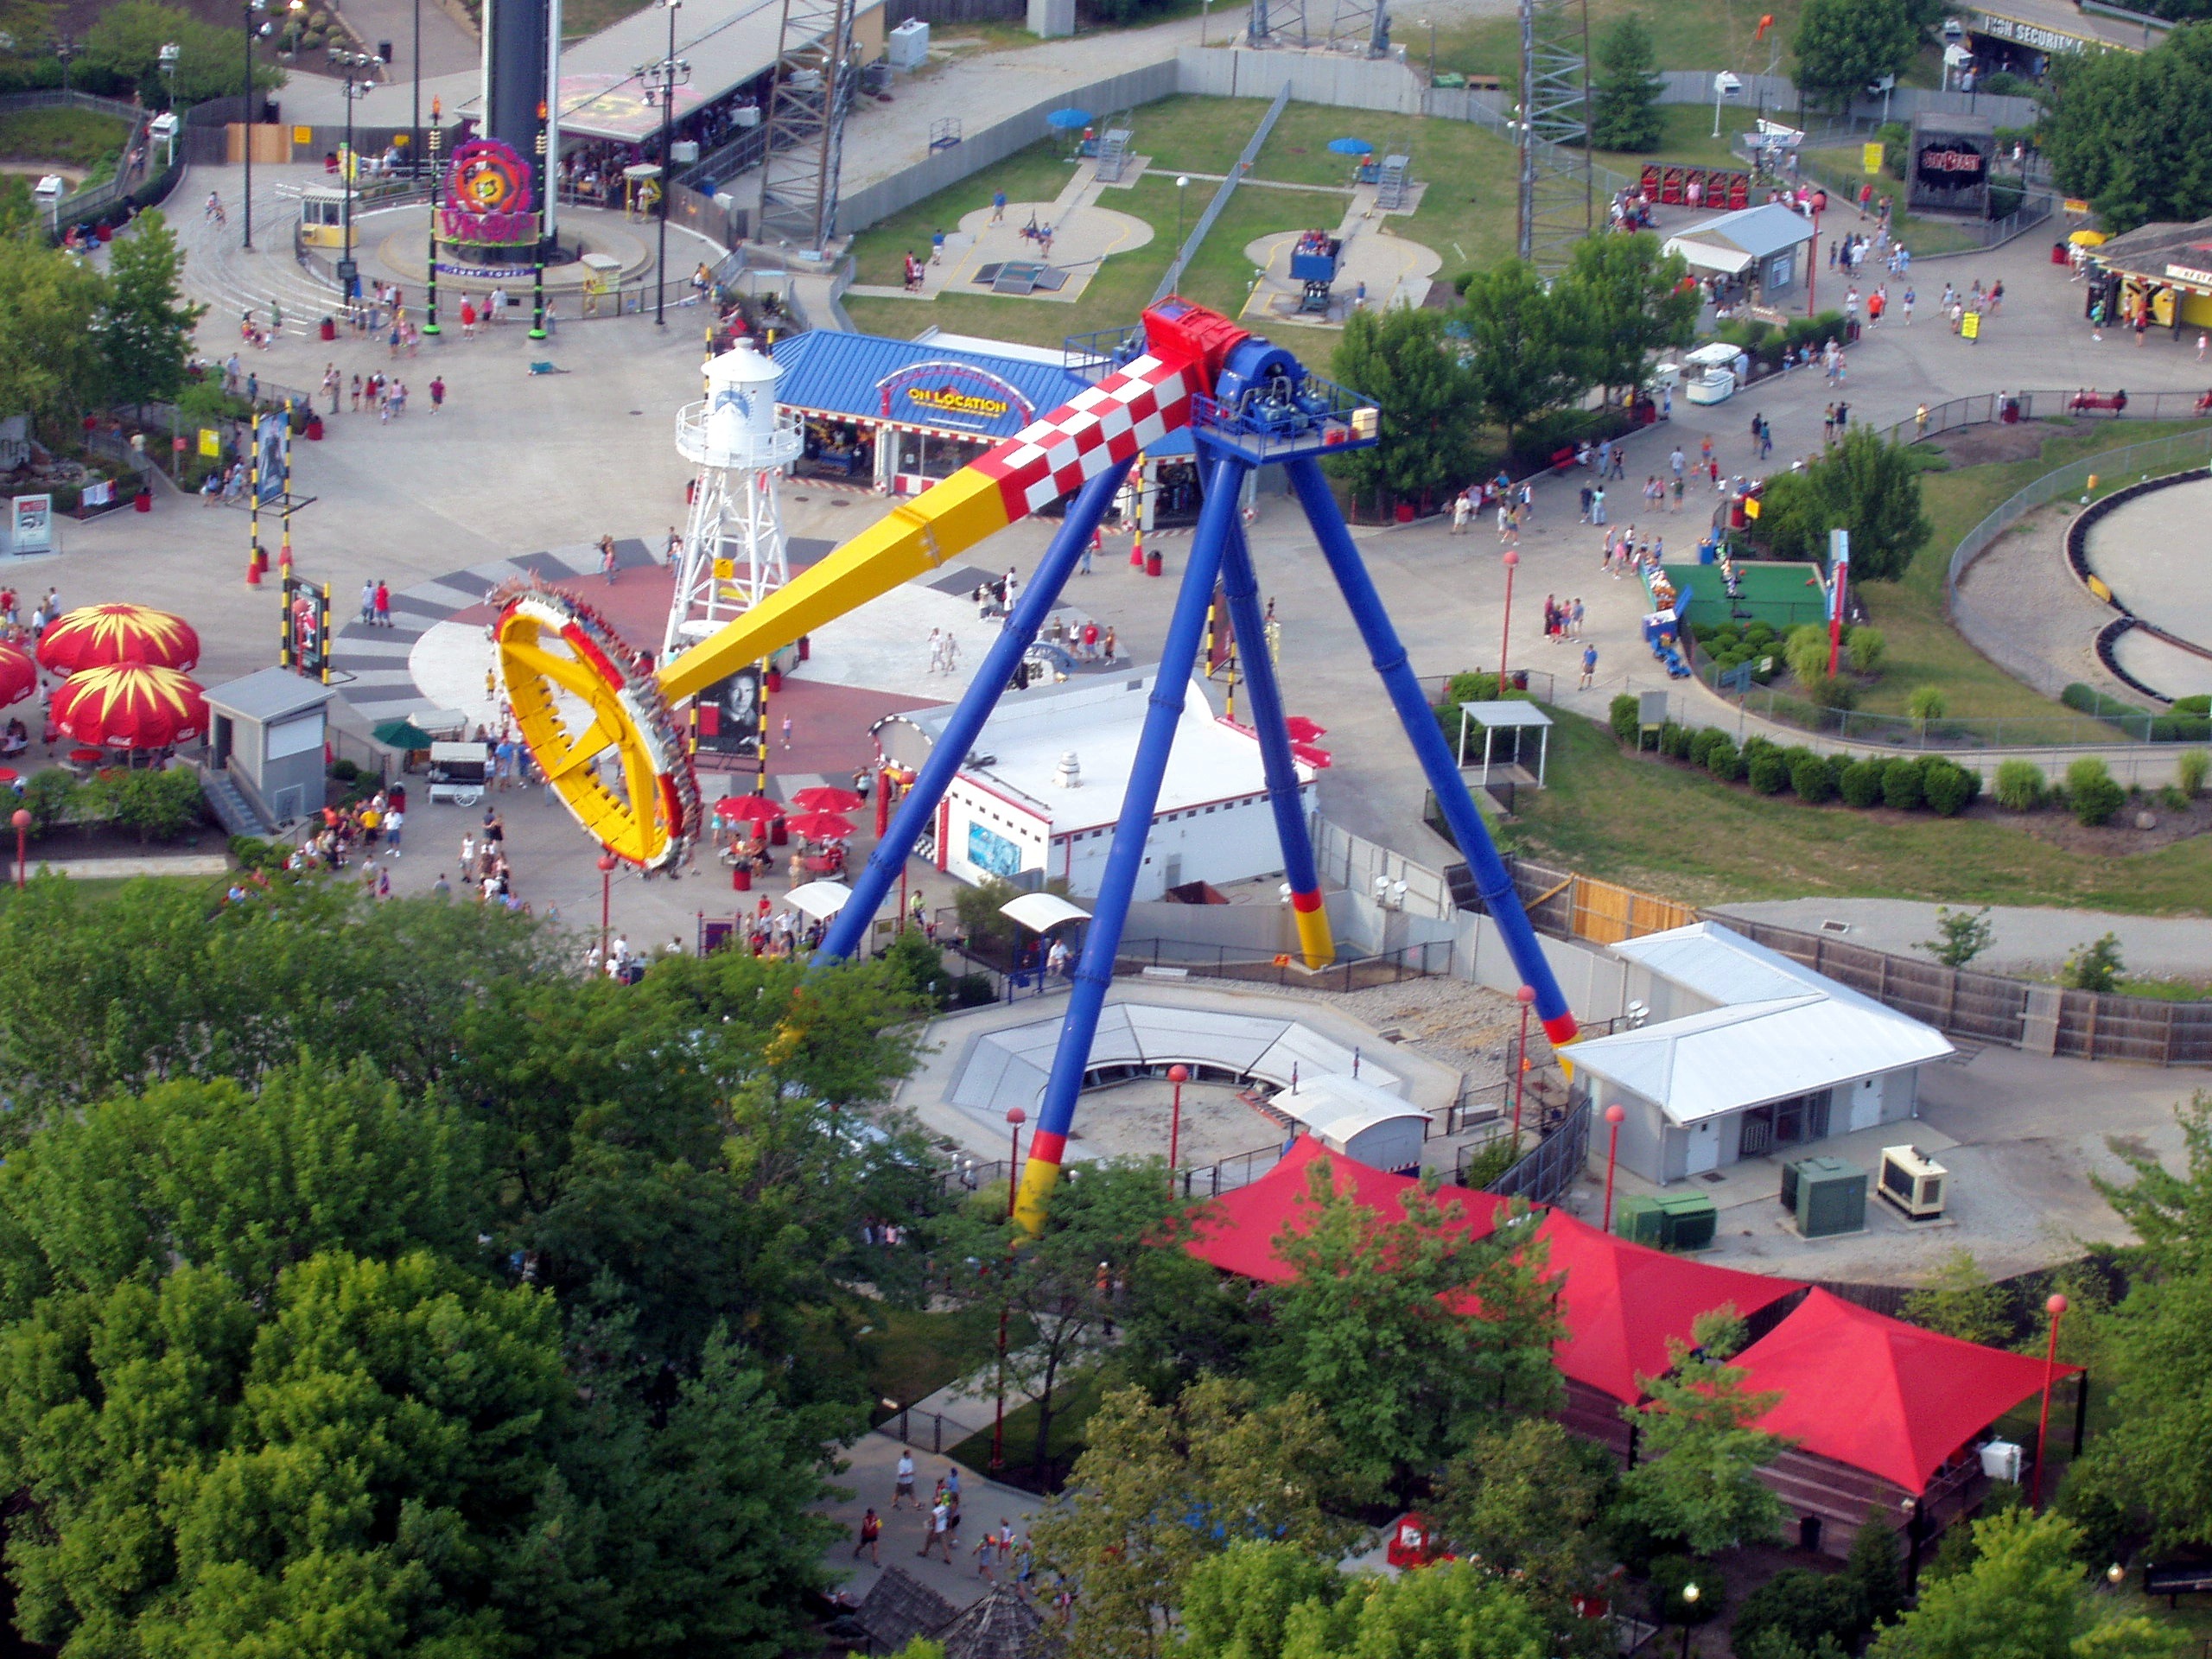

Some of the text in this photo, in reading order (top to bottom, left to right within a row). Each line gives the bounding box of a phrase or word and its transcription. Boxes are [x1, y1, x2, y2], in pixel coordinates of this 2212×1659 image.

[440, 208, 534, 241] DROP
[908, 388, 931, 400] ON
[934, 391, 1007, 413] LOCATION
